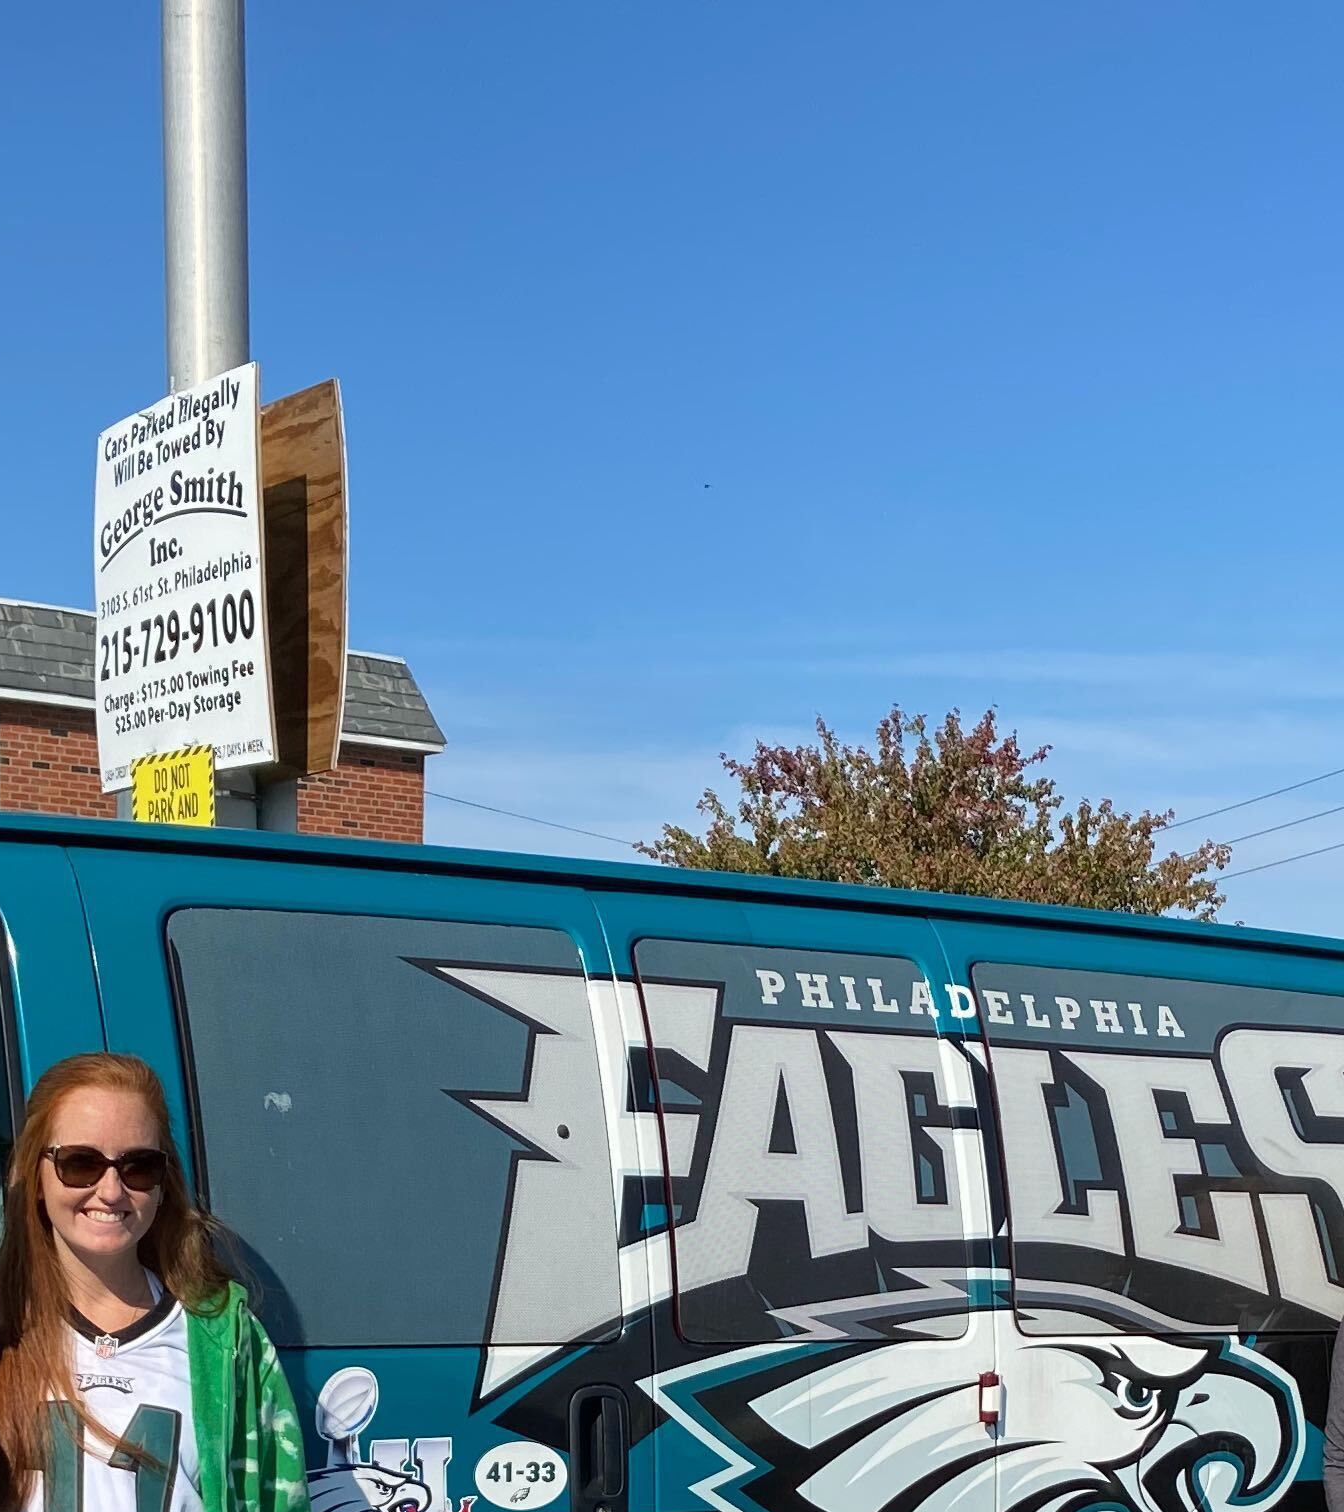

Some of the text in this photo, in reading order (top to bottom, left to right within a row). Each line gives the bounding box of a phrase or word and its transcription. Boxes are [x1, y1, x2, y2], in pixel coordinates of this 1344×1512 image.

[105, 378, 240, 461] Cars Parked Illegally
[114, 419, 225, 487] Will Be Towed By
[101, 467, 243, 557] George Smith
[149, 538, 183, 566] Inc.
[101, 594, 120, 619] 3103
[133, 584, 153, 607] 61st
[158, 577, 172, 597] St.
[175, 551, 252, 591] Philadelphia
[101, 588, 255, 681] 215-729-9100
[142, 674, 184, 703] $175.00
[186, 665, 229, 690] Towing
[232, 660, 254, 680] Fee
[115, 690, 241, 736] $25.00 Per-Day Storage
[154, 768, 167, 793] DO
[171, 763, 190, 791] NOT
[148, 792, 198, 823] PARK AND
[756, 968, 1186, 1038] PHILADELPHIA
[486, 1461, 556, 1483] 41-33
